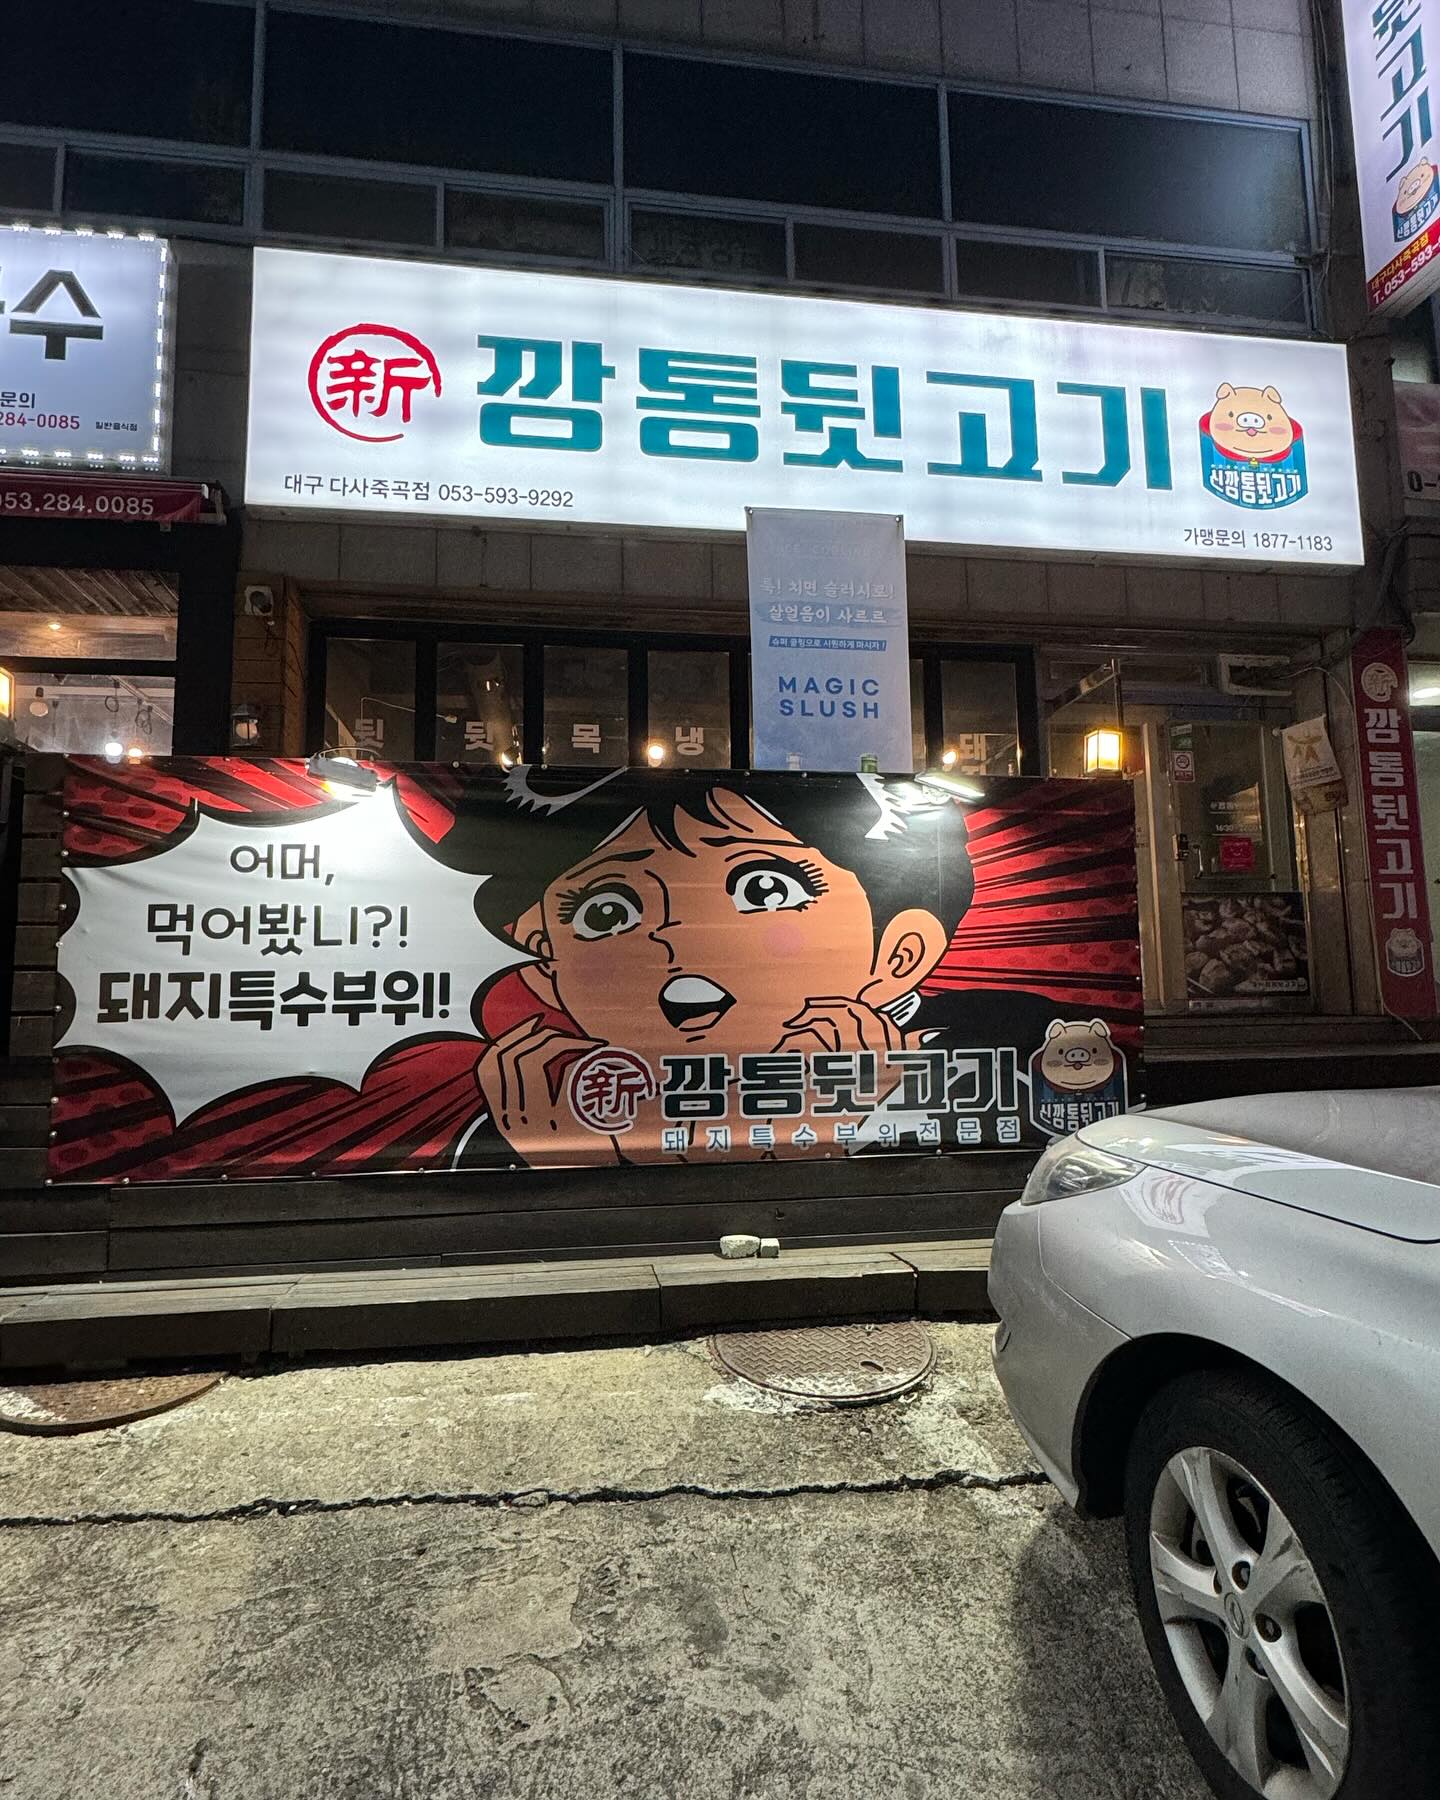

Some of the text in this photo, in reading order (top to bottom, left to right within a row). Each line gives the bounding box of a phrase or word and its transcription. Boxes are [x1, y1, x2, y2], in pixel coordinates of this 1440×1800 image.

[0, 266, 104, 361] 수
[477, 334, 1172, 490] 깜통뒷고기
[0, 492, 154, 515] 53.284.0085
[284, 474, 574, 508] 대구 다사죽곡점 053-593-9292
[1209, 468, 1302, 505] 신깜통뒷고기
[1184, 528, 1333, 552] 가맹문의 1877-1183
[769, 605, 887, 624] 살얼음이 사르르
[778, 676, 880, 696] MAGIC
[779, 699, 880, 719] SLUSH
[1364, 708, 1418, 920] 깜통뒷고기
[230, 843, 335, 886] 어머,
[147, 903, 409, 957] 먹어봤니?!
[97, 970, 452, 1031] 돼지특수부위!
[662, 1048, 1017, 1119] 깜통뒷고기
